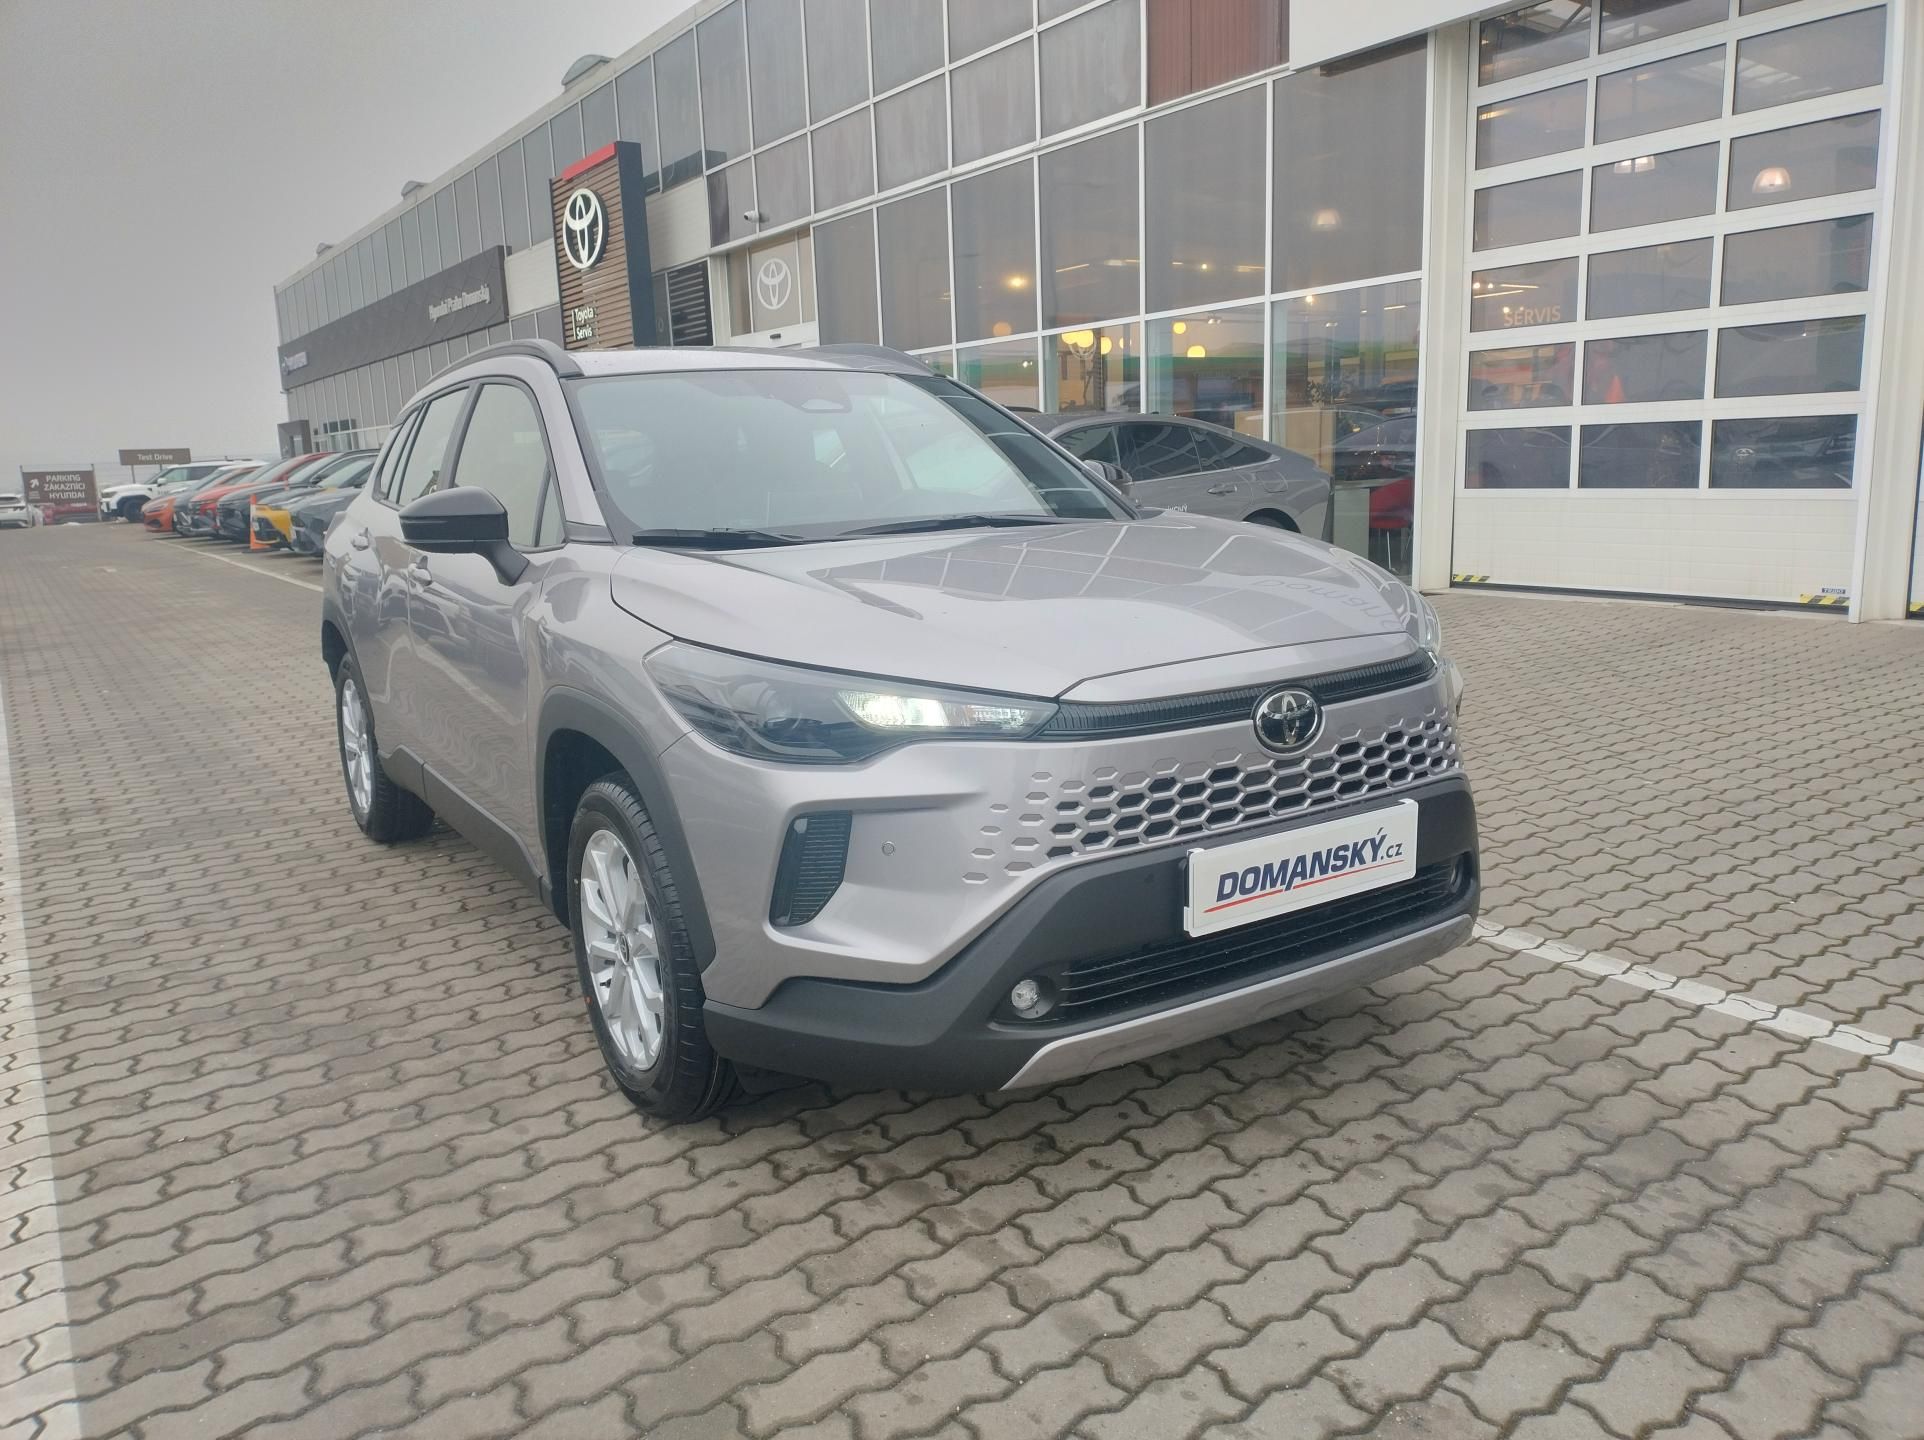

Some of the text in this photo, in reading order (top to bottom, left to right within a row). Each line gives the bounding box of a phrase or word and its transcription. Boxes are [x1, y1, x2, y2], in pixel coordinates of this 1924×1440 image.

[574, 306, 594, 324] Toyota
[1503, 305, 1561, 328] SERVIS
[576, 324, 593, 340] Servis
[137, 453, 173, 461] Test Drive
[46, 474, 81, 482] PARKING
[49, 491, 85, 499] HYUNDAI
